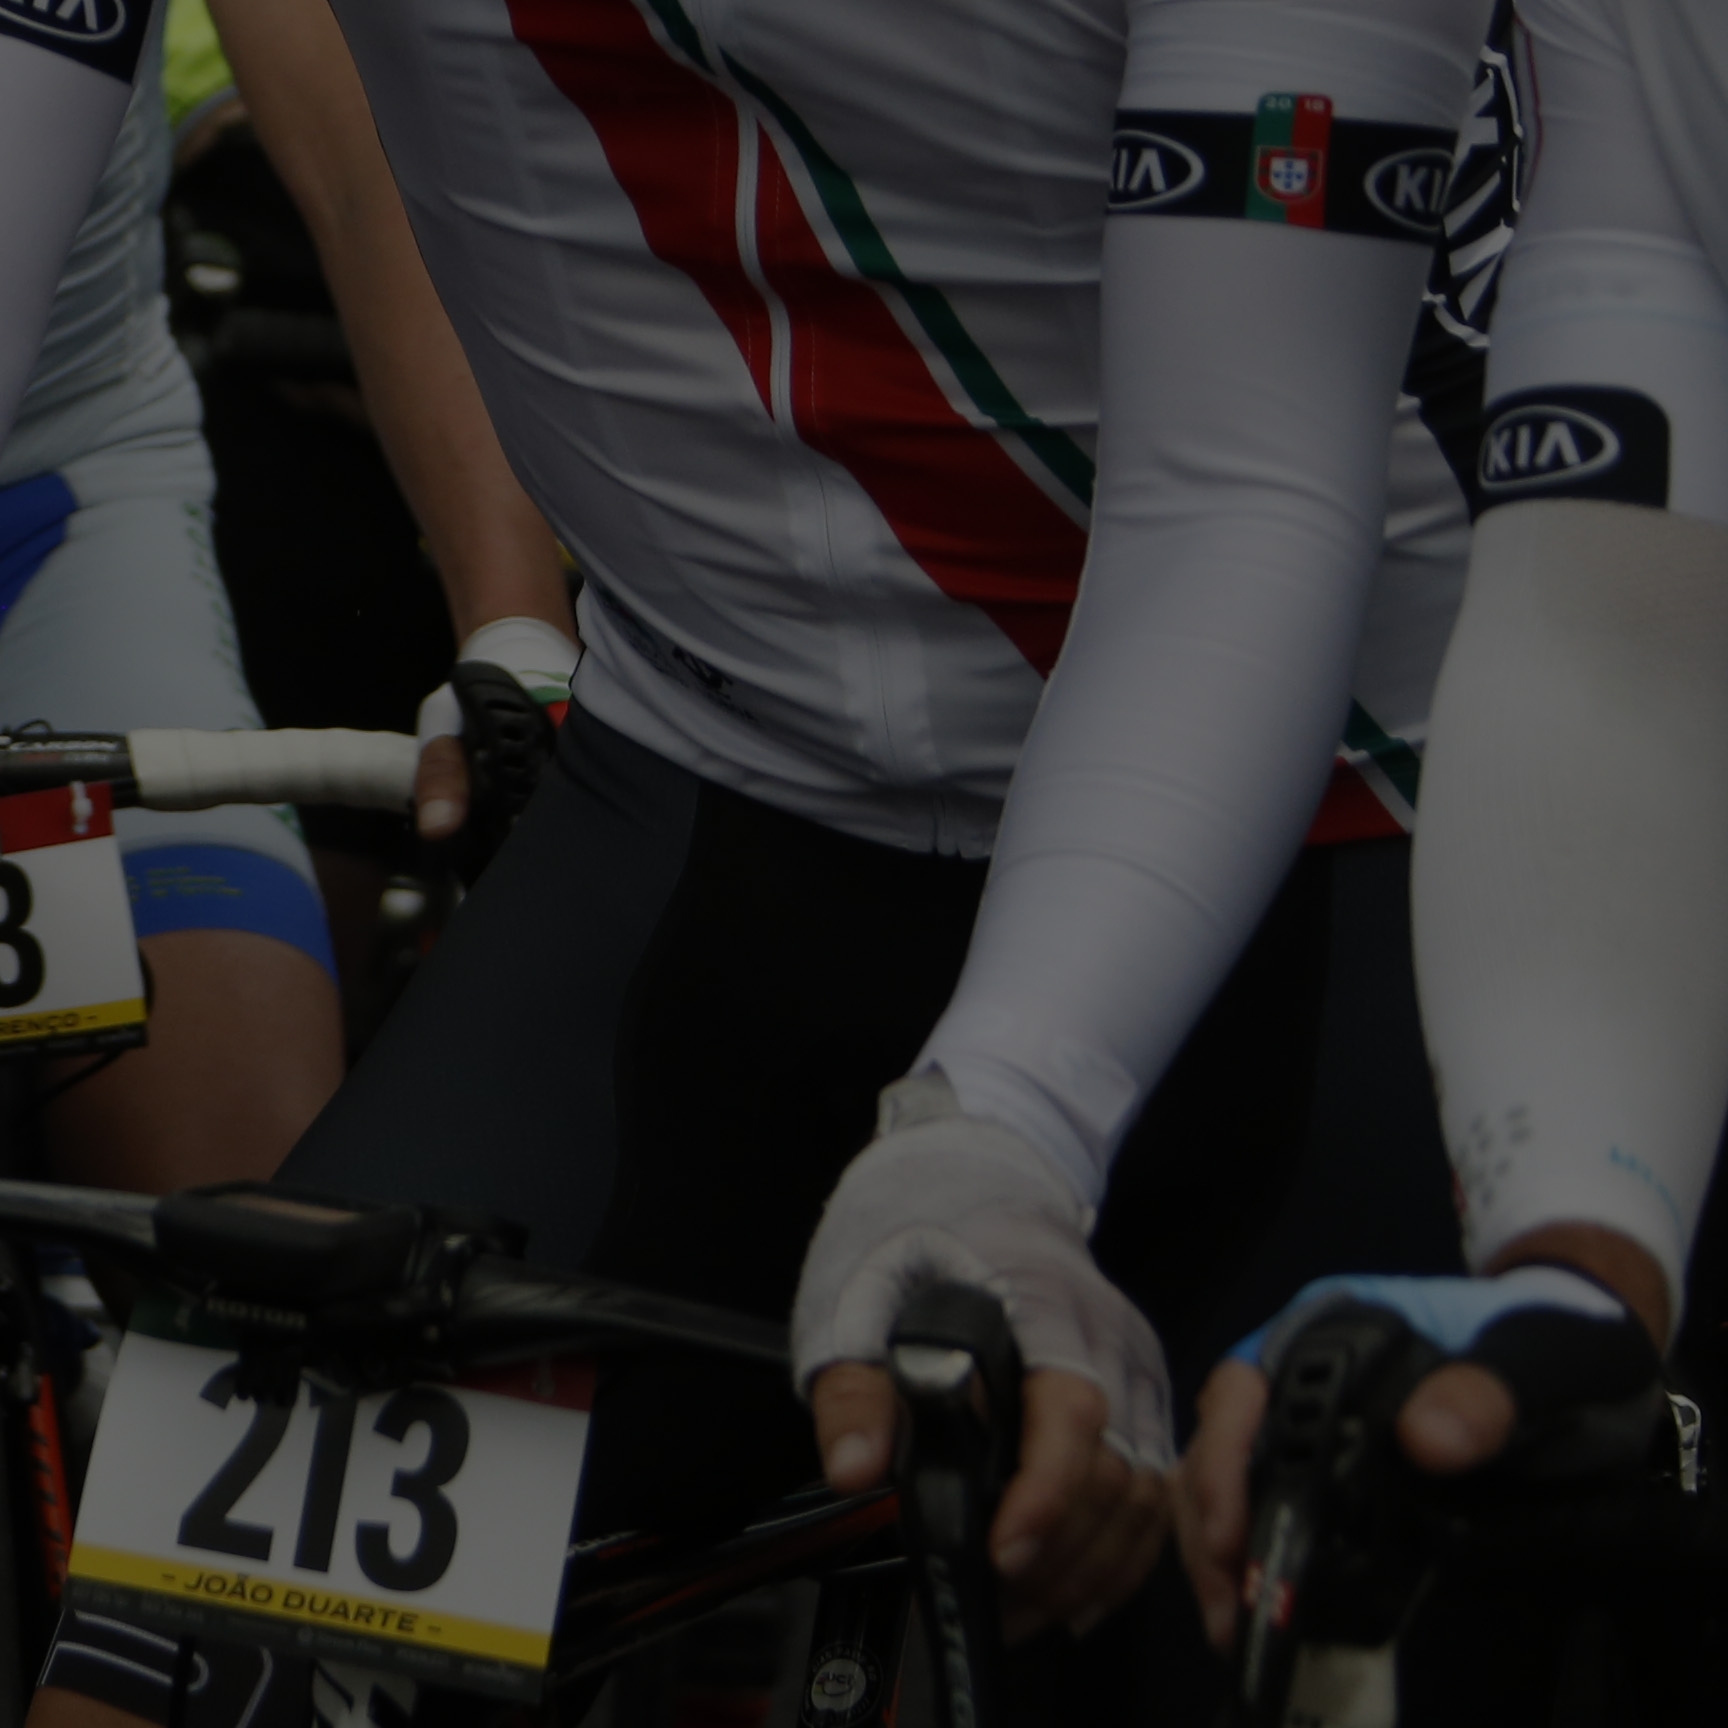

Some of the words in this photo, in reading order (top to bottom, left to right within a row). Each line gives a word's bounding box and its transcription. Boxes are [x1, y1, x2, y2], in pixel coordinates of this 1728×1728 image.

[1487, 420, 1583, 478] KIA
[178, 1362, 470, 1593] 213
[184, 1572, 276, 1609] JOÃO
[283, 1590, 418, 1633] DUARTE
